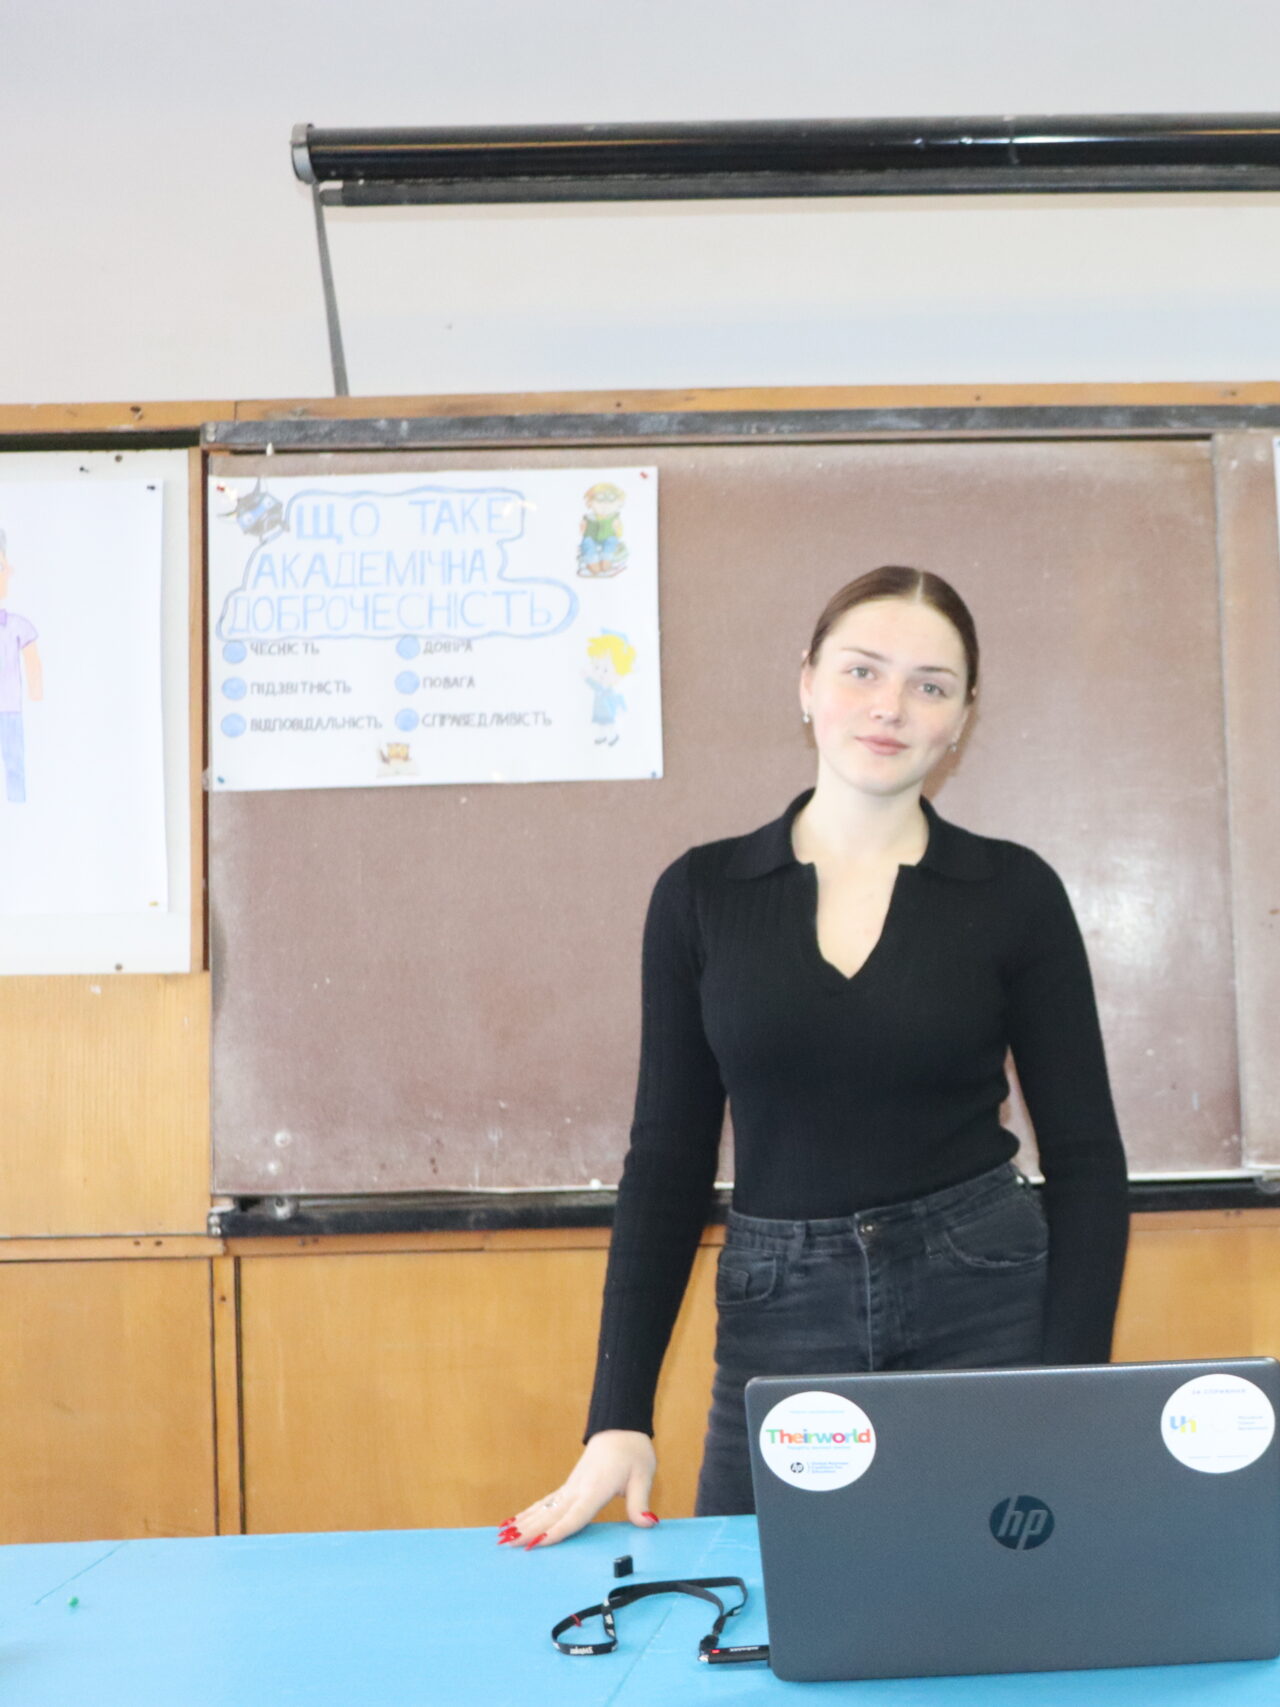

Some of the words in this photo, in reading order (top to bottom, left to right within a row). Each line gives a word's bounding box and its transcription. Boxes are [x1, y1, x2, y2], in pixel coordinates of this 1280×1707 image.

[296, 501, 380, 545] ЩО
[408, 496, 513, 536] ТАКЕ
[252, 547, 489, 589] АКАДЕМІЧНА
[228, 589, 553, 637] ДОБРОЧЕСНІСТЬ
[766, 1428, 871, 1444] Theirworld
[991, 1494, 1053, 1550] hp
